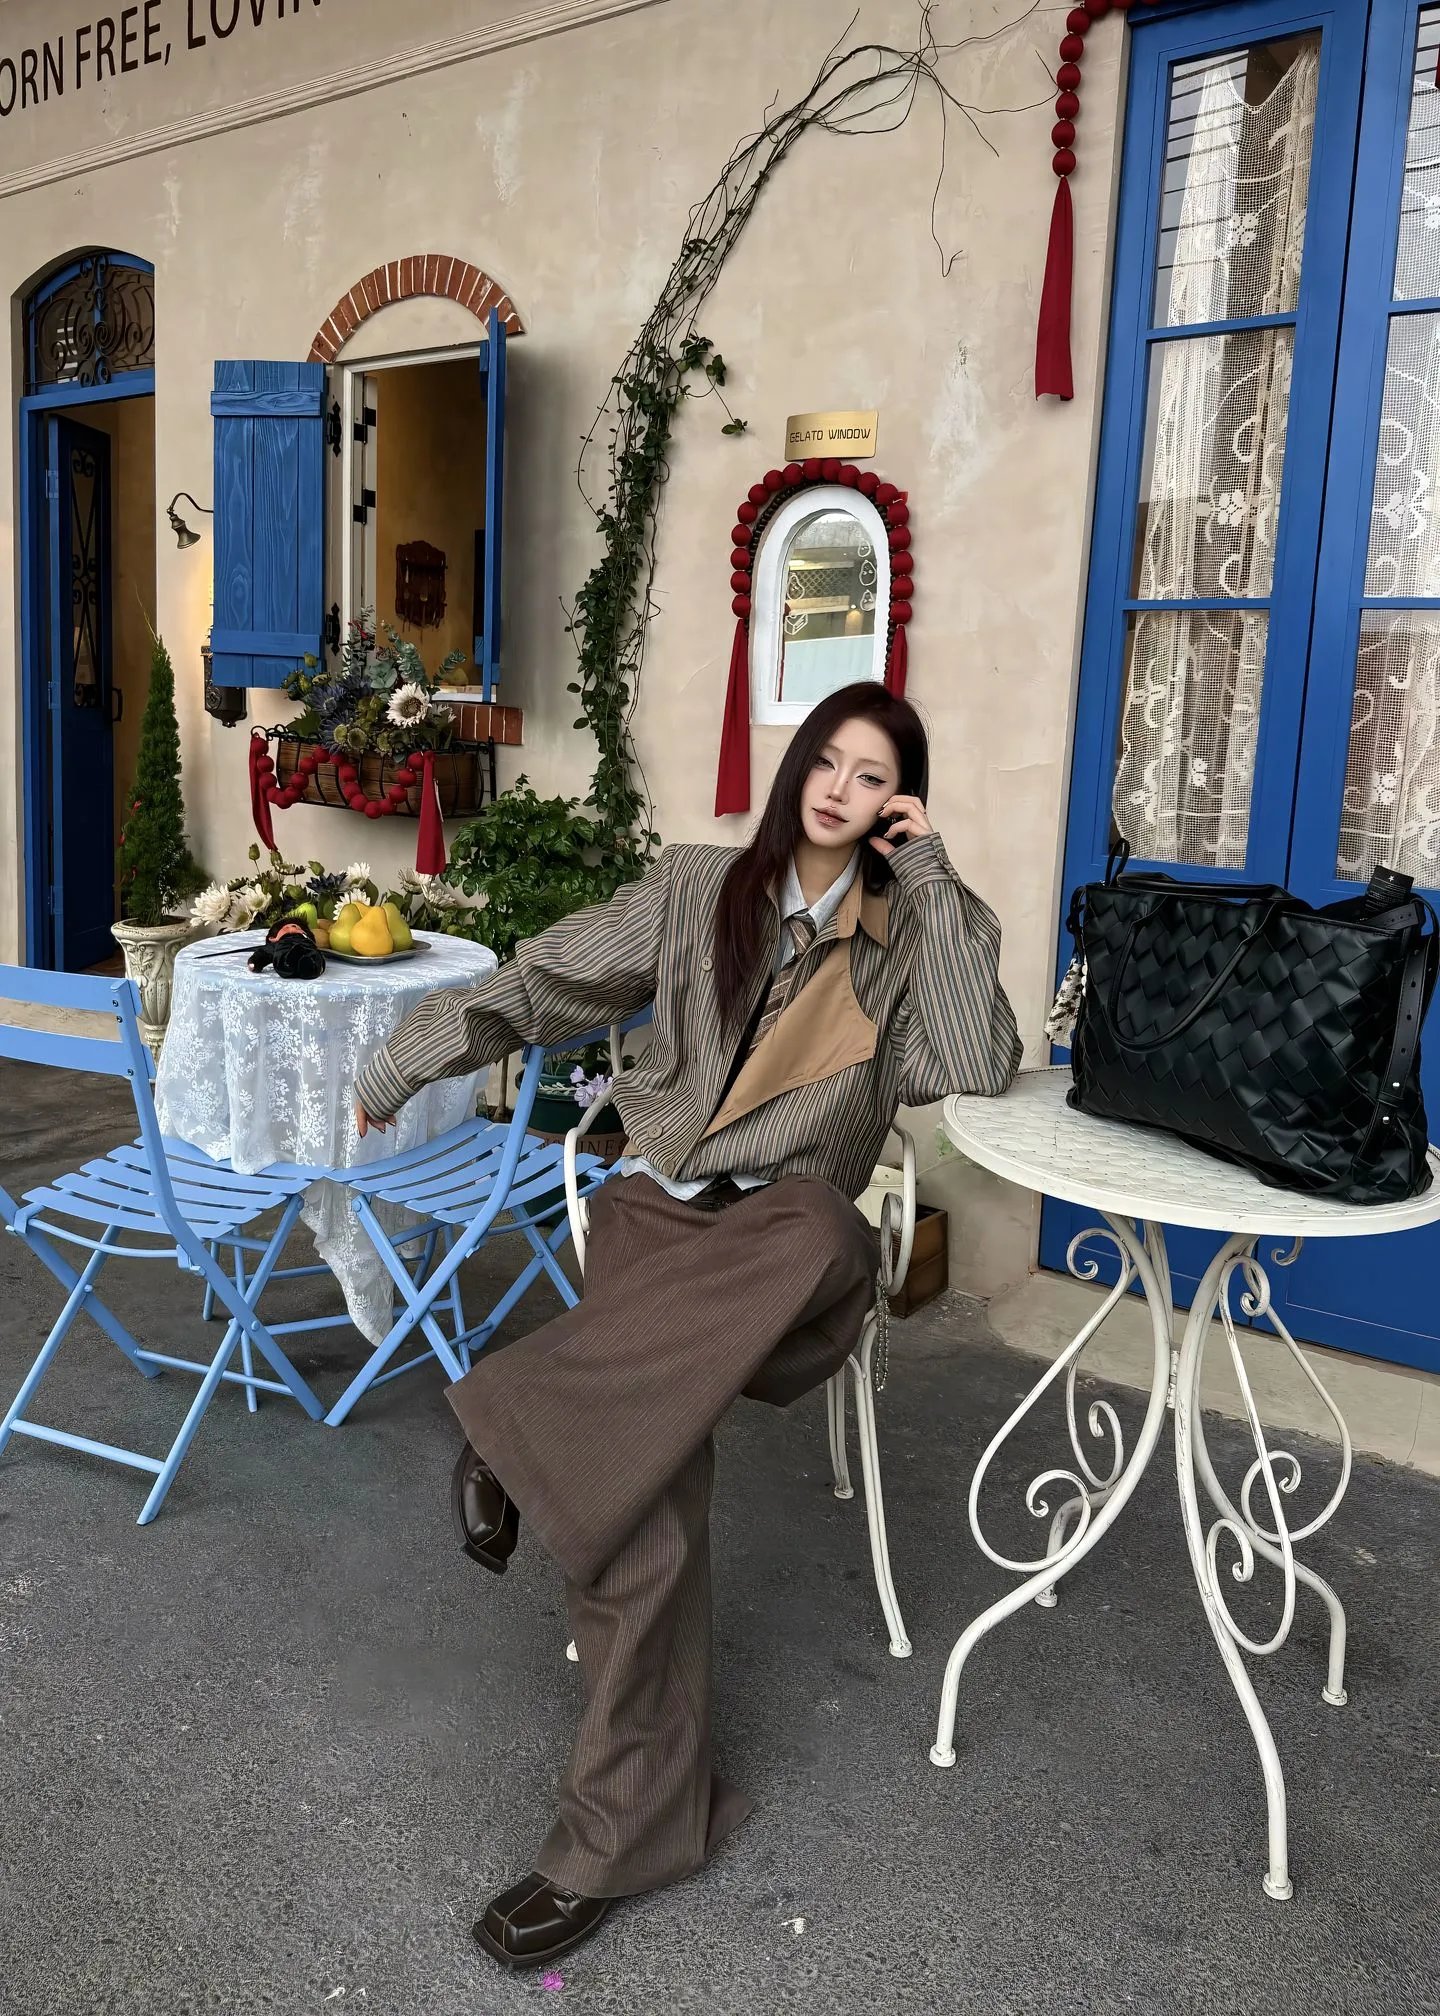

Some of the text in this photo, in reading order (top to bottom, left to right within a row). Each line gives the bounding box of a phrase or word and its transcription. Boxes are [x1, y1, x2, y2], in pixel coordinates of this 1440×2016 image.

[76, 0, 171, 90] FREE,
[789, 428, 871, 443] GELATO WINDOW
